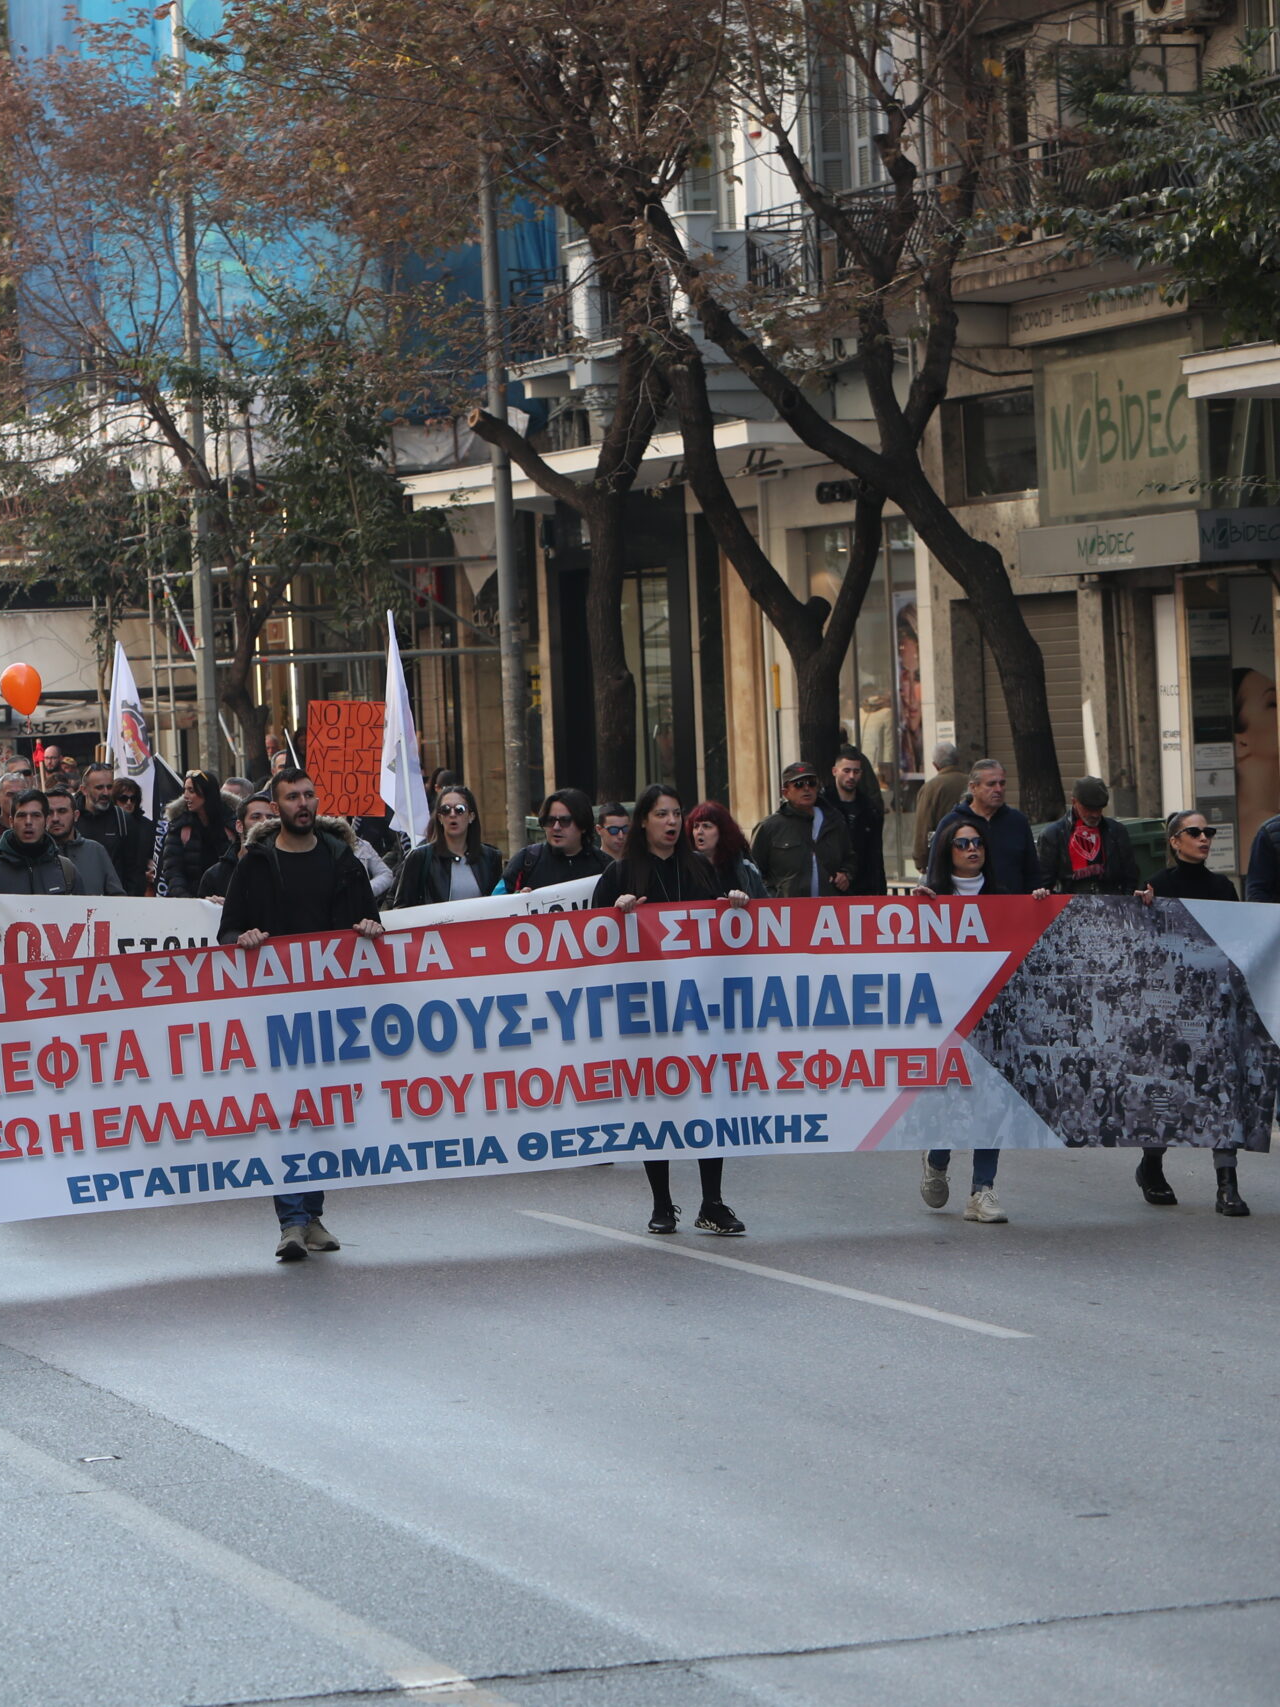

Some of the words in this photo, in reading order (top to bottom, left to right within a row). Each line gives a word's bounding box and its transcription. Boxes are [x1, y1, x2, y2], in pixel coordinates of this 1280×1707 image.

[308, 726, 384, 750] ΧΩΡΙΣ
[309, 703, 386, 727] ΝΟΤΟΣ
[322, 793, 376, 816] 2012
[26, 962, 121, 1011] ΣΤΑ
[141, 930, 453, 998] ΣΥΝΔΙΚΑΤΑ
[505, 911, 639, 964] ΟΛΟΙ
[661, 905, 791, 951] ΣΤΟΝ
[810, 903, 989, 947] ΑΓΩΝΑ
[168, 1019, 256, 1077] ΓΙΑ
[48, 1111, 85, 1154] Η
[92, 1092, 282, 1149] ΕΛΛΑΔΑ
[380, 1073, 474, 1120] ΤΟΥ
[483, 1053, 718, 1112] ΠΟΛΕΜΟΥ
[721, 1051, 770, 1092] ΤΑ
[776, 1047, 973, 1090] ΣΦΑΓΕΙΑ
[67, 1157, 274, 1204] ΕΡΓΑΤΙΚΑ
[281, 1135, 508, 1184] ΣΩΜΑΤΕΙΑ
[517, 1113, 829, 1162] ΘΕΣΣΑΛΟΝΙΚΗΣ
